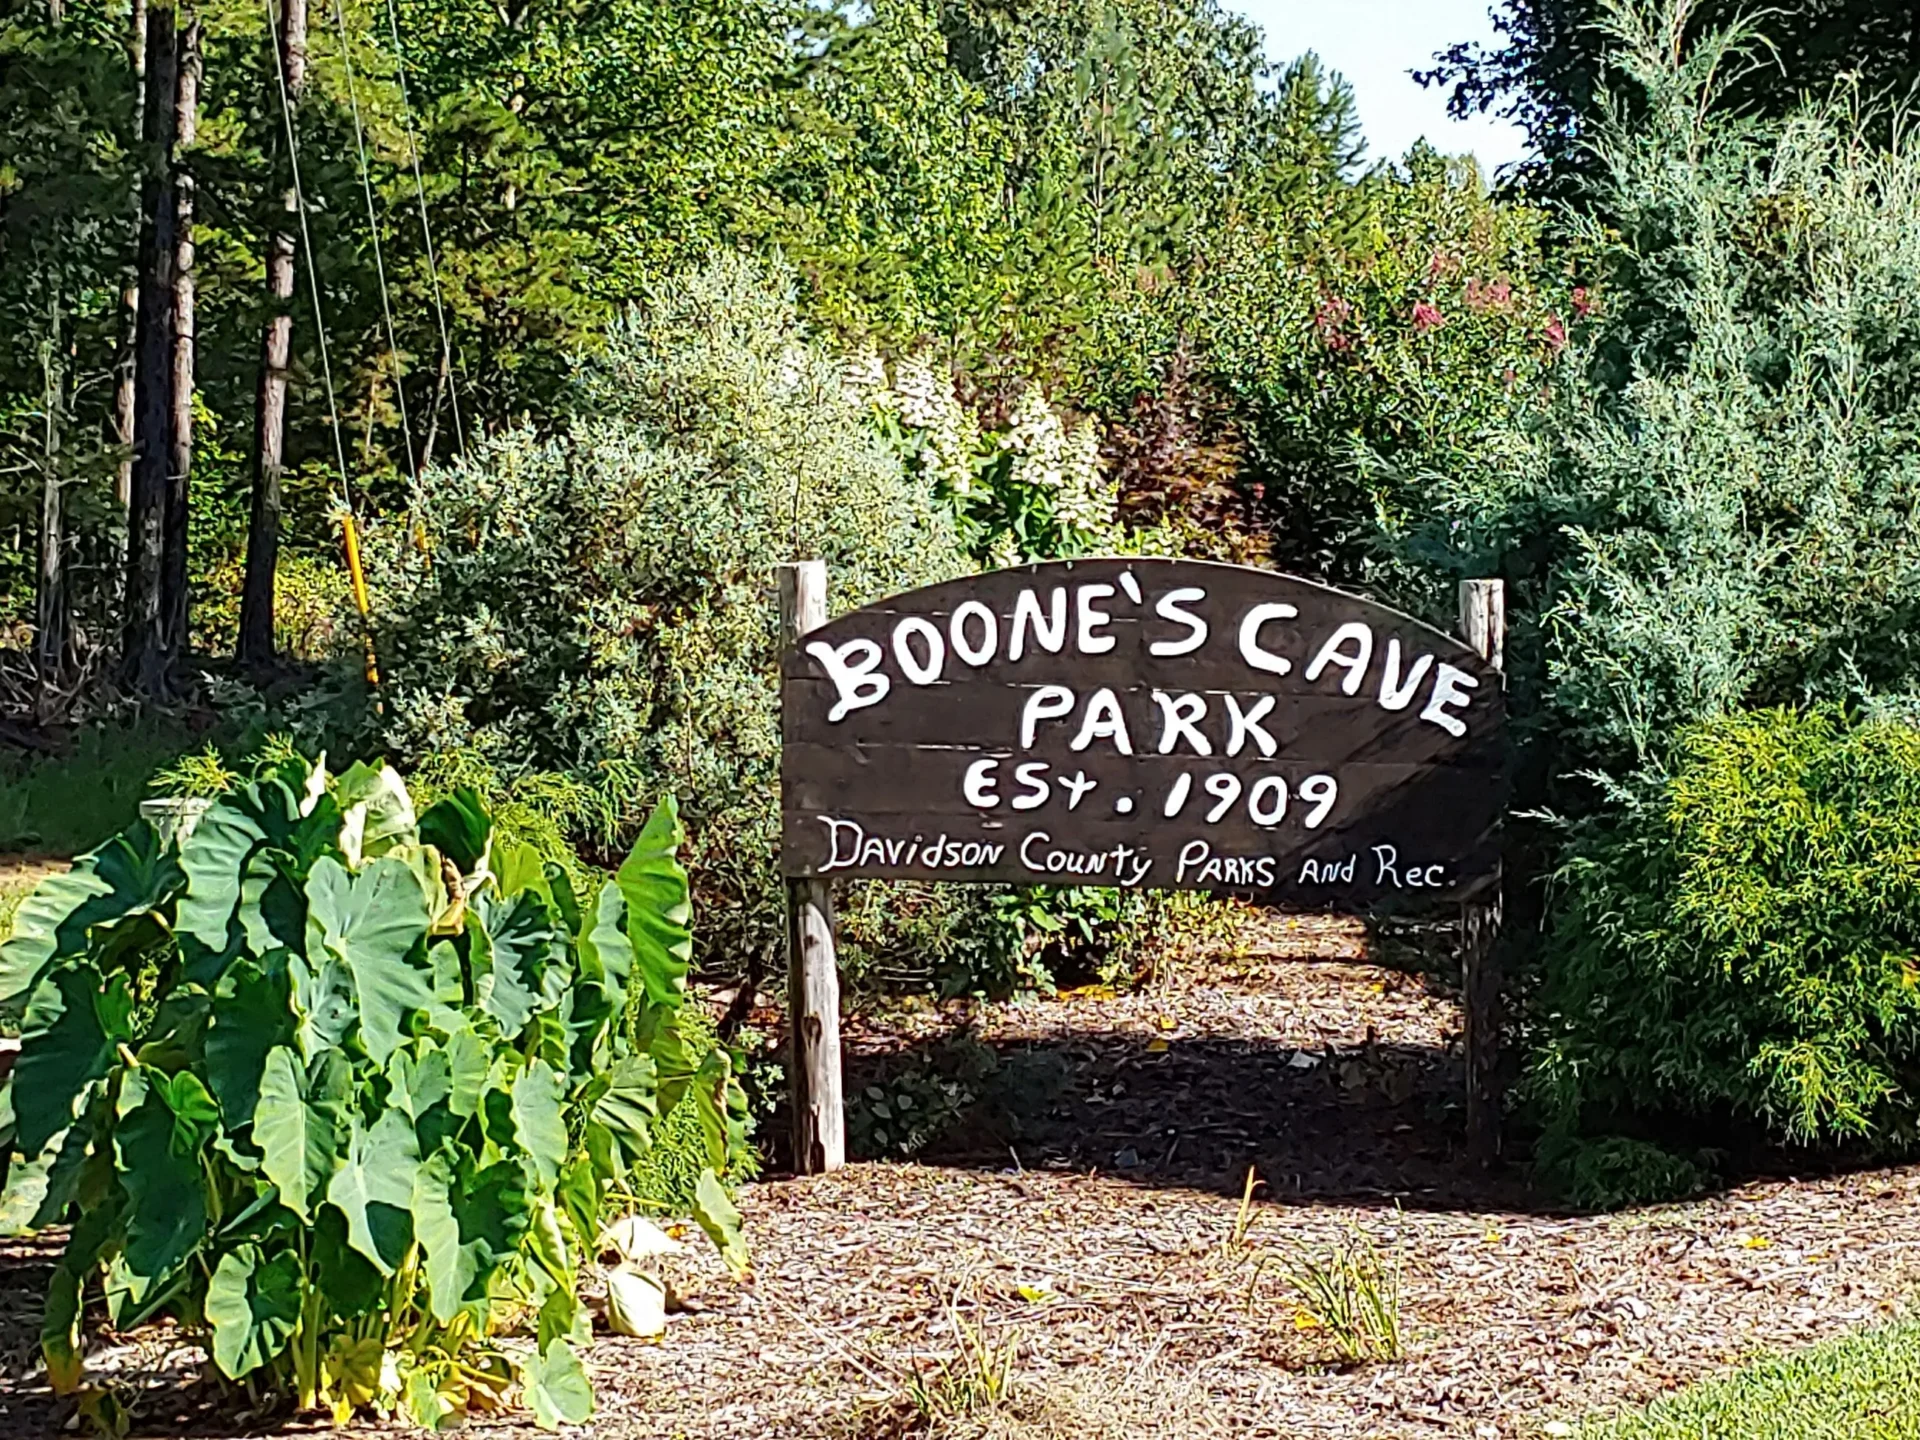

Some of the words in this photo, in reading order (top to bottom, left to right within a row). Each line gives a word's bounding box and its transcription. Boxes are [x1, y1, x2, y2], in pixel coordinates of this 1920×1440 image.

[807, 572, 1207, 720] BOONE'S
[1239, 602, 1479, 737] CAVE
[1020, 686, 1277, 757] PARK
[1164, 773, 1338, 829] 1909
